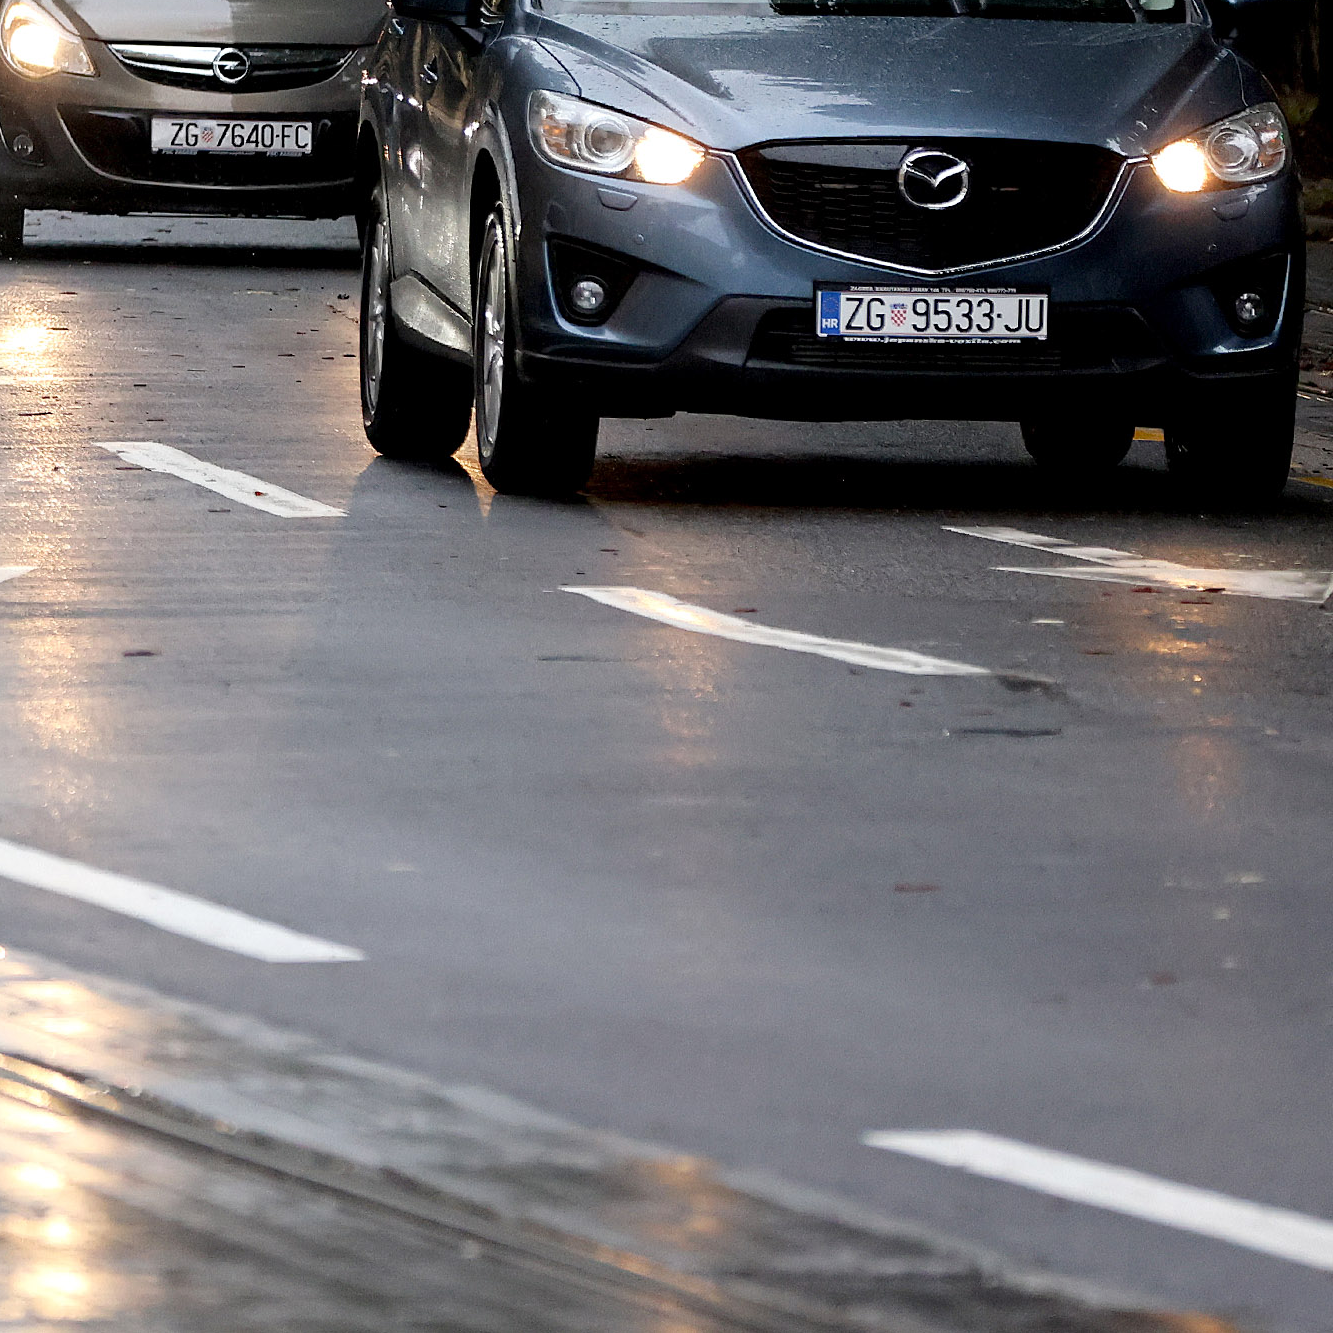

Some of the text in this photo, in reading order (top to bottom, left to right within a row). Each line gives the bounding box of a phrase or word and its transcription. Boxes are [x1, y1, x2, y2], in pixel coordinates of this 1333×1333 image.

[170, 123, 199, 147] ZG
[822, 318, 839, 329] HR
[845, 297, 885, 332] ZG
